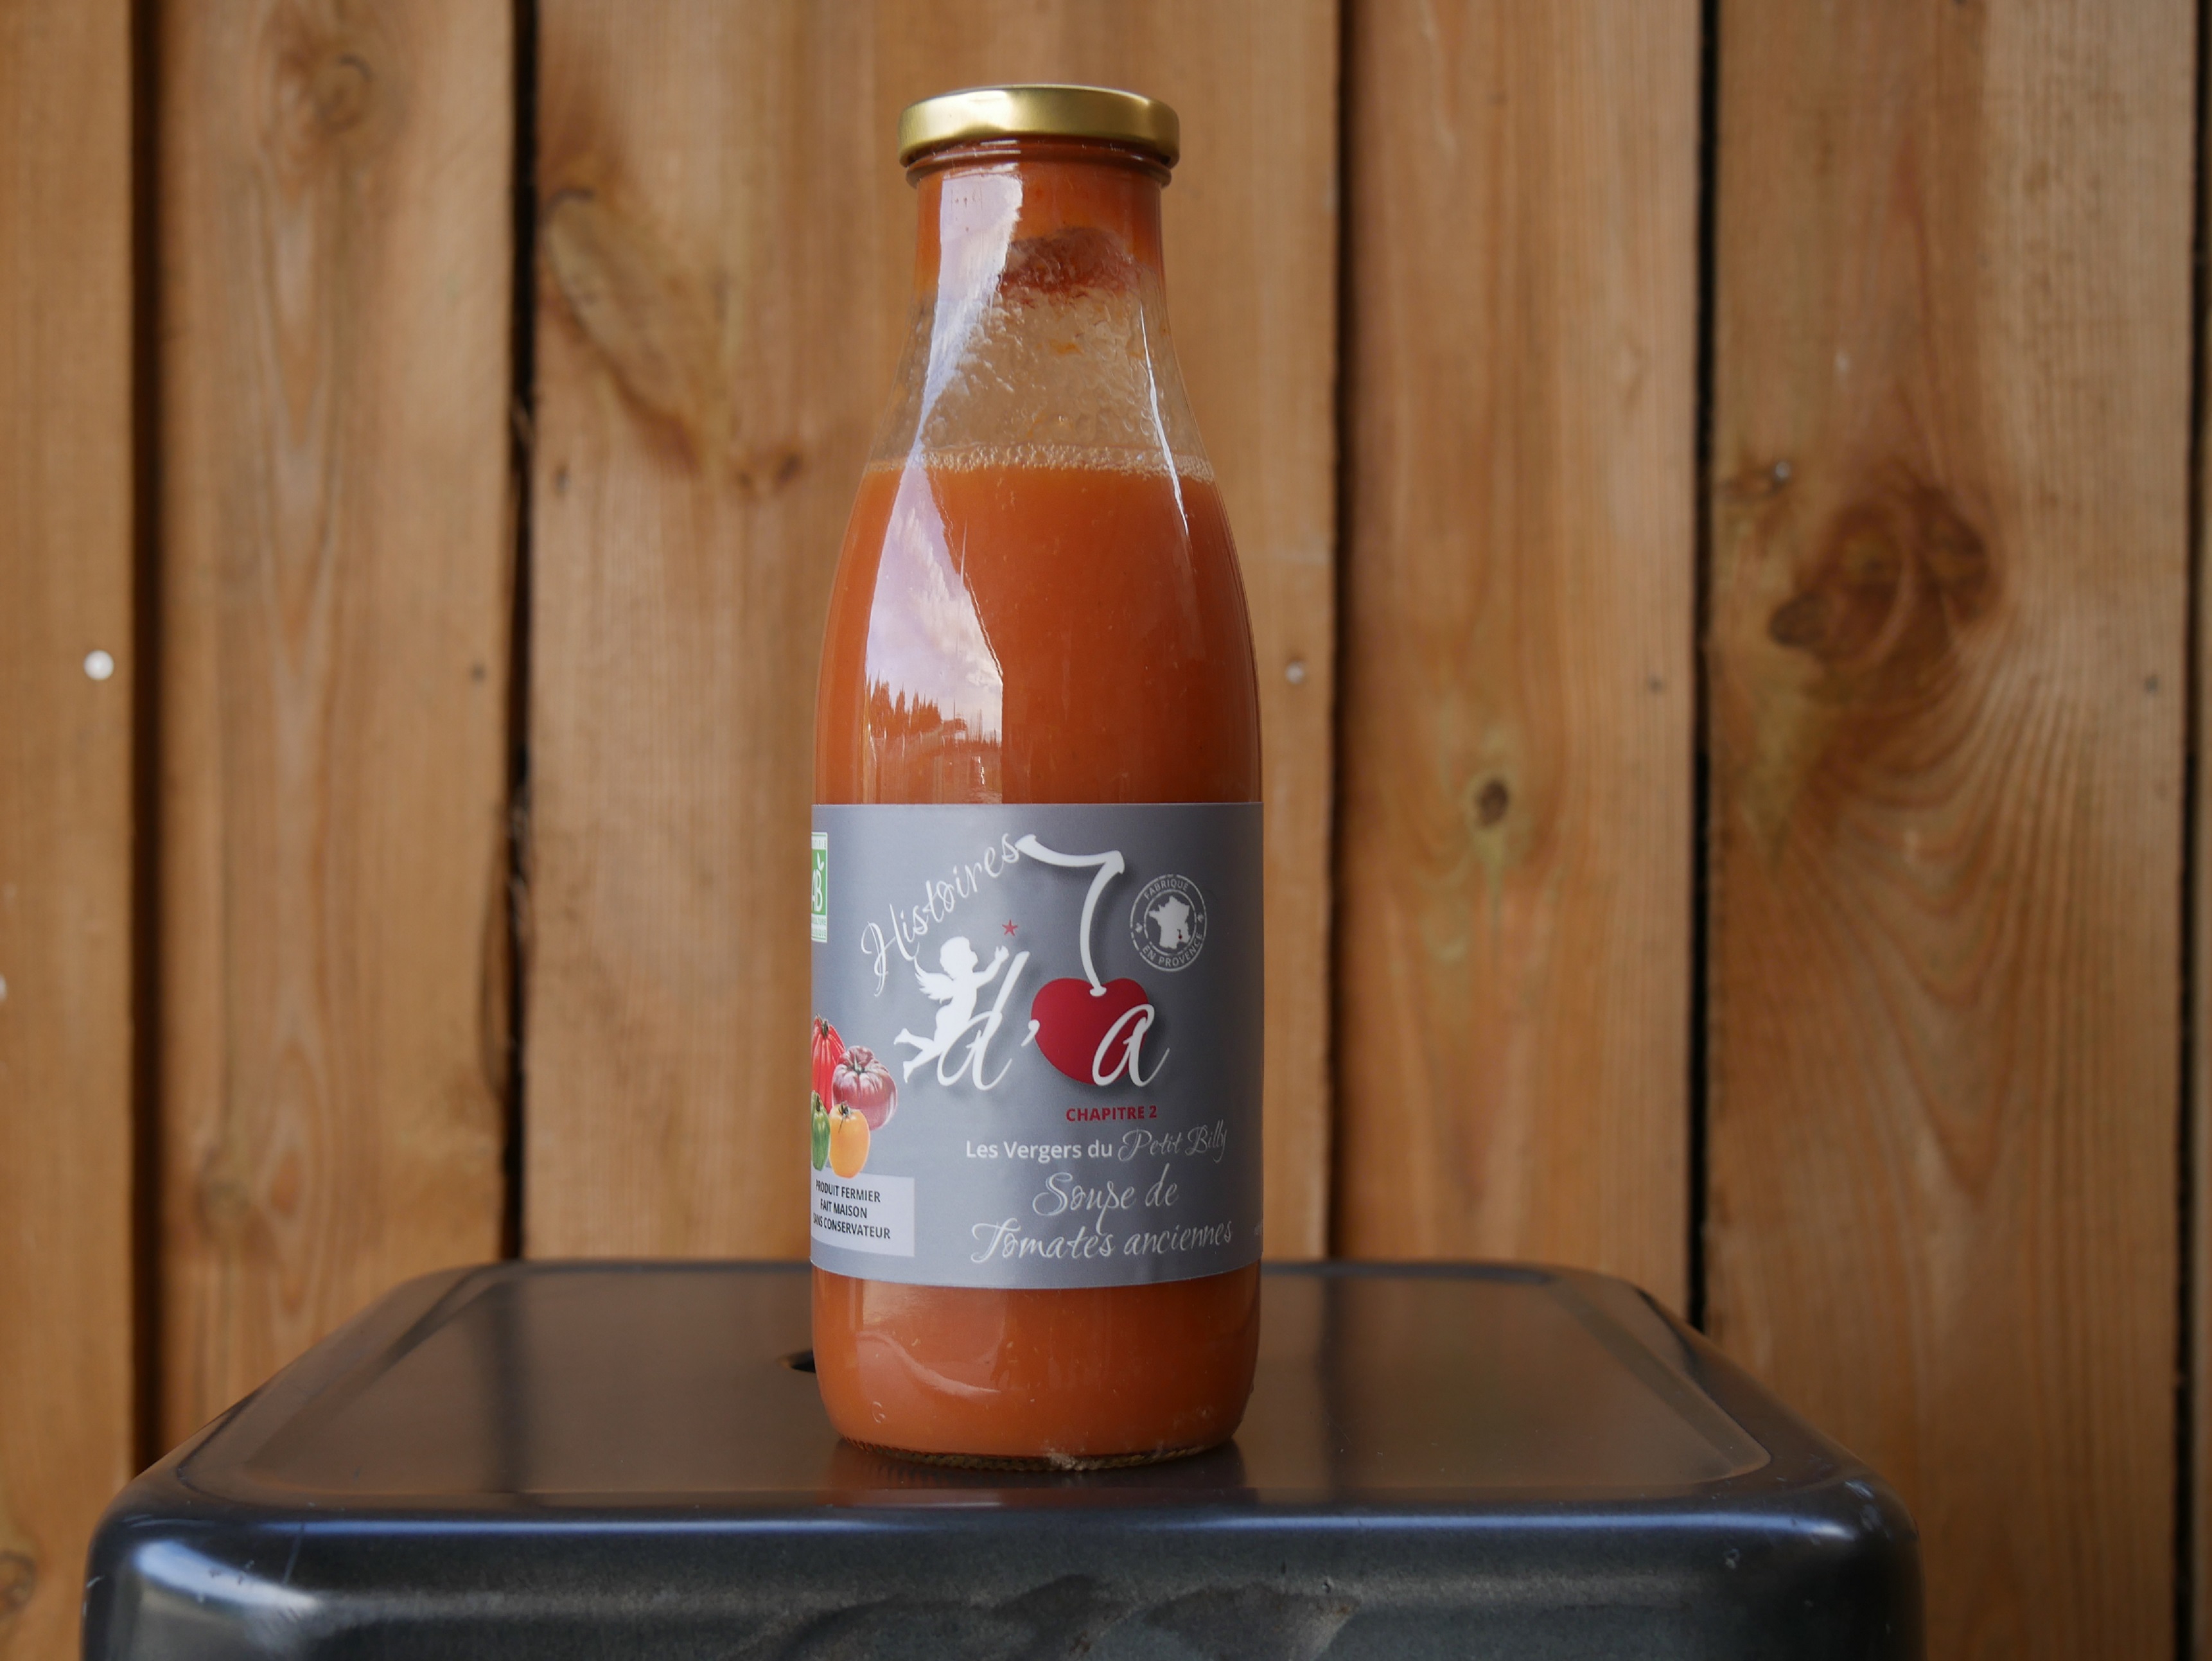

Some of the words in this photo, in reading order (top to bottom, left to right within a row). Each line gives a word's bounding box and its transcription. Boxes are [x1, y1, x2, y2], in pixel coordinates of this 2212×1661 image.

[861, 833, 1019, 997] Histoires
[1142, 945, 1156, 960] EN
[1158, 932, 1202, 967] PROVENCE
[1066, 1105, 1145, 1122] CHAPITRE
[1148, 1105, 1158, 1118] 2
[966, 1140, 998, 1158] Les
[1003, 1141, 1082, 1164] Vergers
[1087, 1139, 1112, 1158] du
[1118, 1129, 1182, 1161] Petit
[1185, 1119, 1227, 1163] Billy
[816, 1179, 839, 1197] PRODUIT
[841, 1186, 881, 1203] FERMIER
[820, 1198, 832, 1213] FAIT
[833, 1202, 868, 1218] MAISON
[1031, 1172, 1136, 1235] Soupe
[1145, 1163, 1179, 1207] de
[823, 1217, 891, 1239] CONSERVATEUR
[970, 1217, 1115, 1263] Tomates
[1123, 1220, 1233, 1255] anciennes
